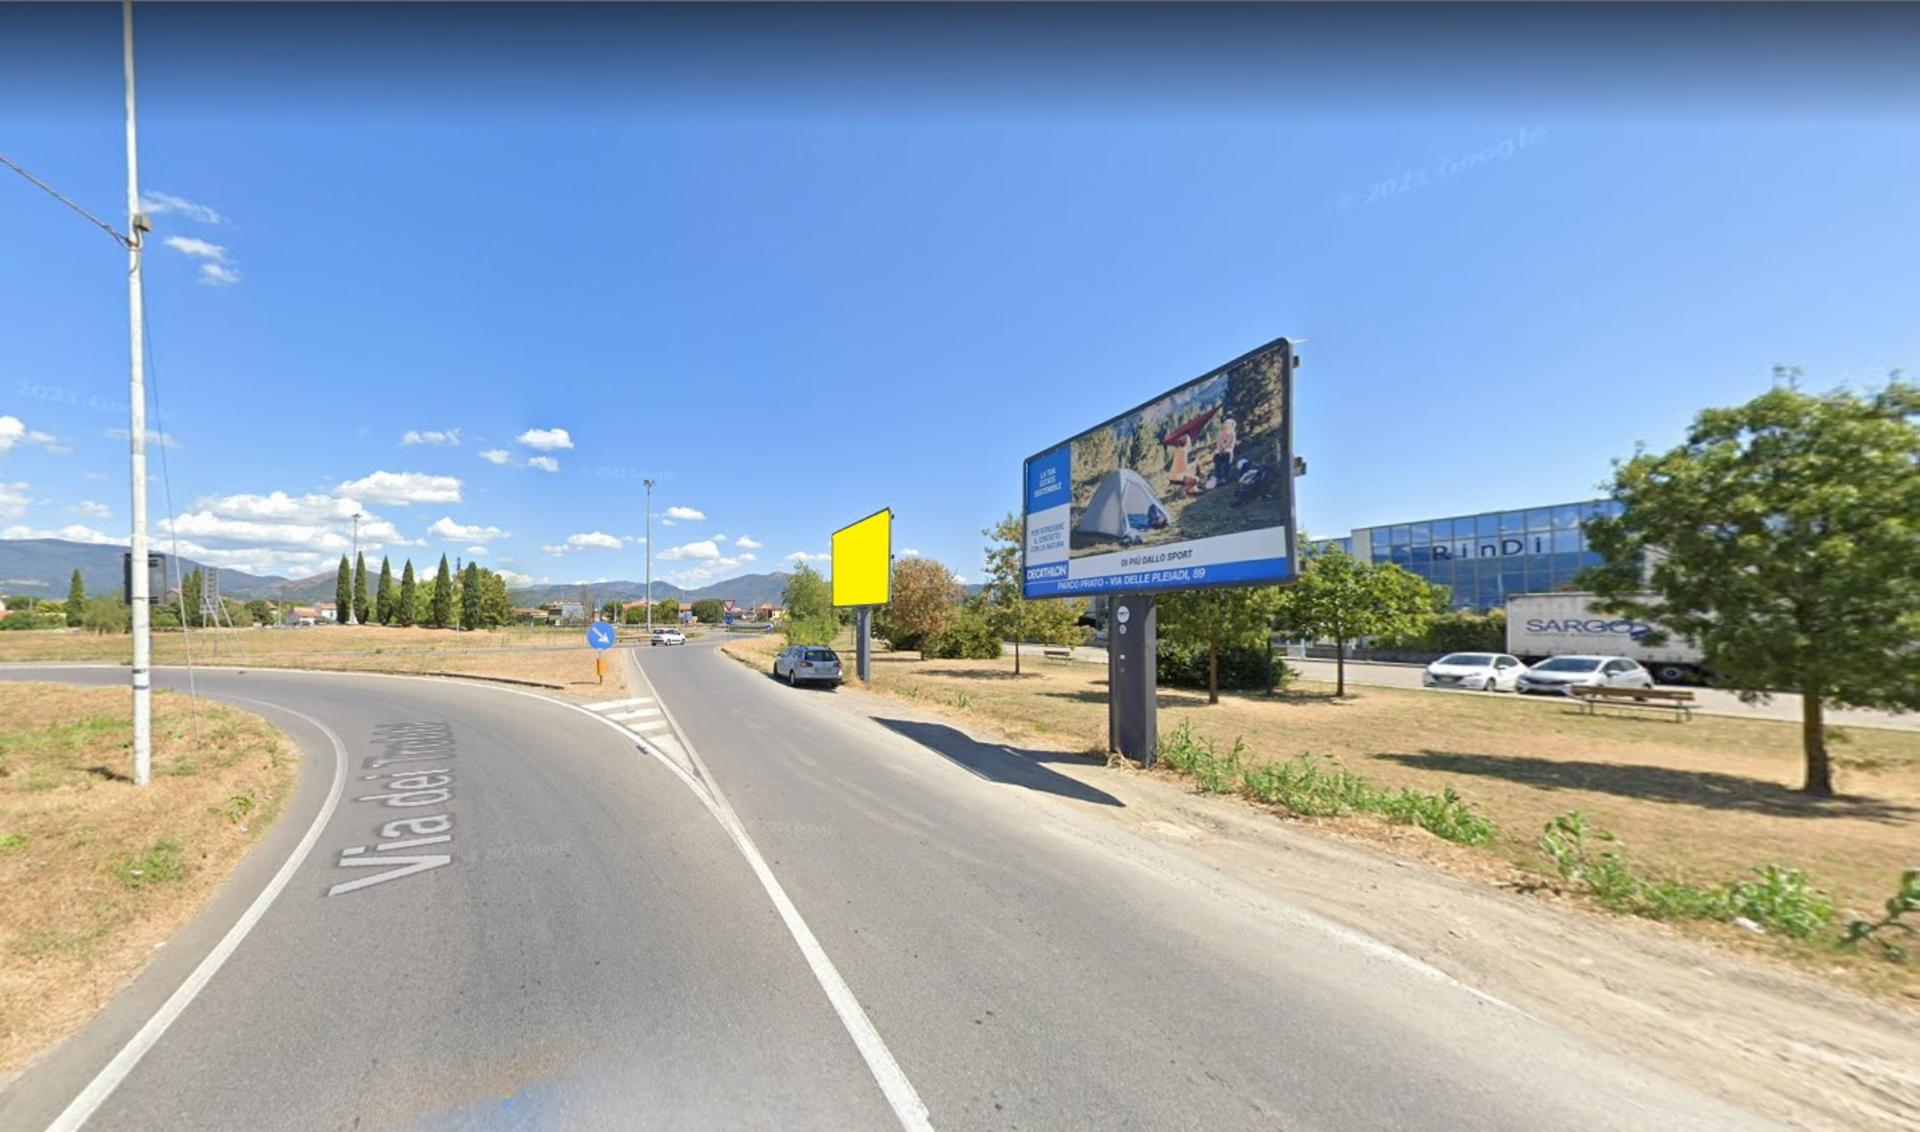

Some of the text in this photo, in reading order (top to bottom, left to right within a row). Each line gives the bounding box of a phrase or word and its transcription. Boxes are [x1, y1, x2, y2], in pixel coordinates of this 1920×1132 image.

[1142, 554, 1165, 564] DALLO
[1167, 550, 1193, 560] SPORT
[1027, 565, 1067, 580] DECATHLON
[1109, 576, 1122, 586] VIA
[1124, 572, 1150, 585] DELLE
[1152, 568, 1190, 583] PLEIADI,
[1193, 567, 1206, 579] 89
